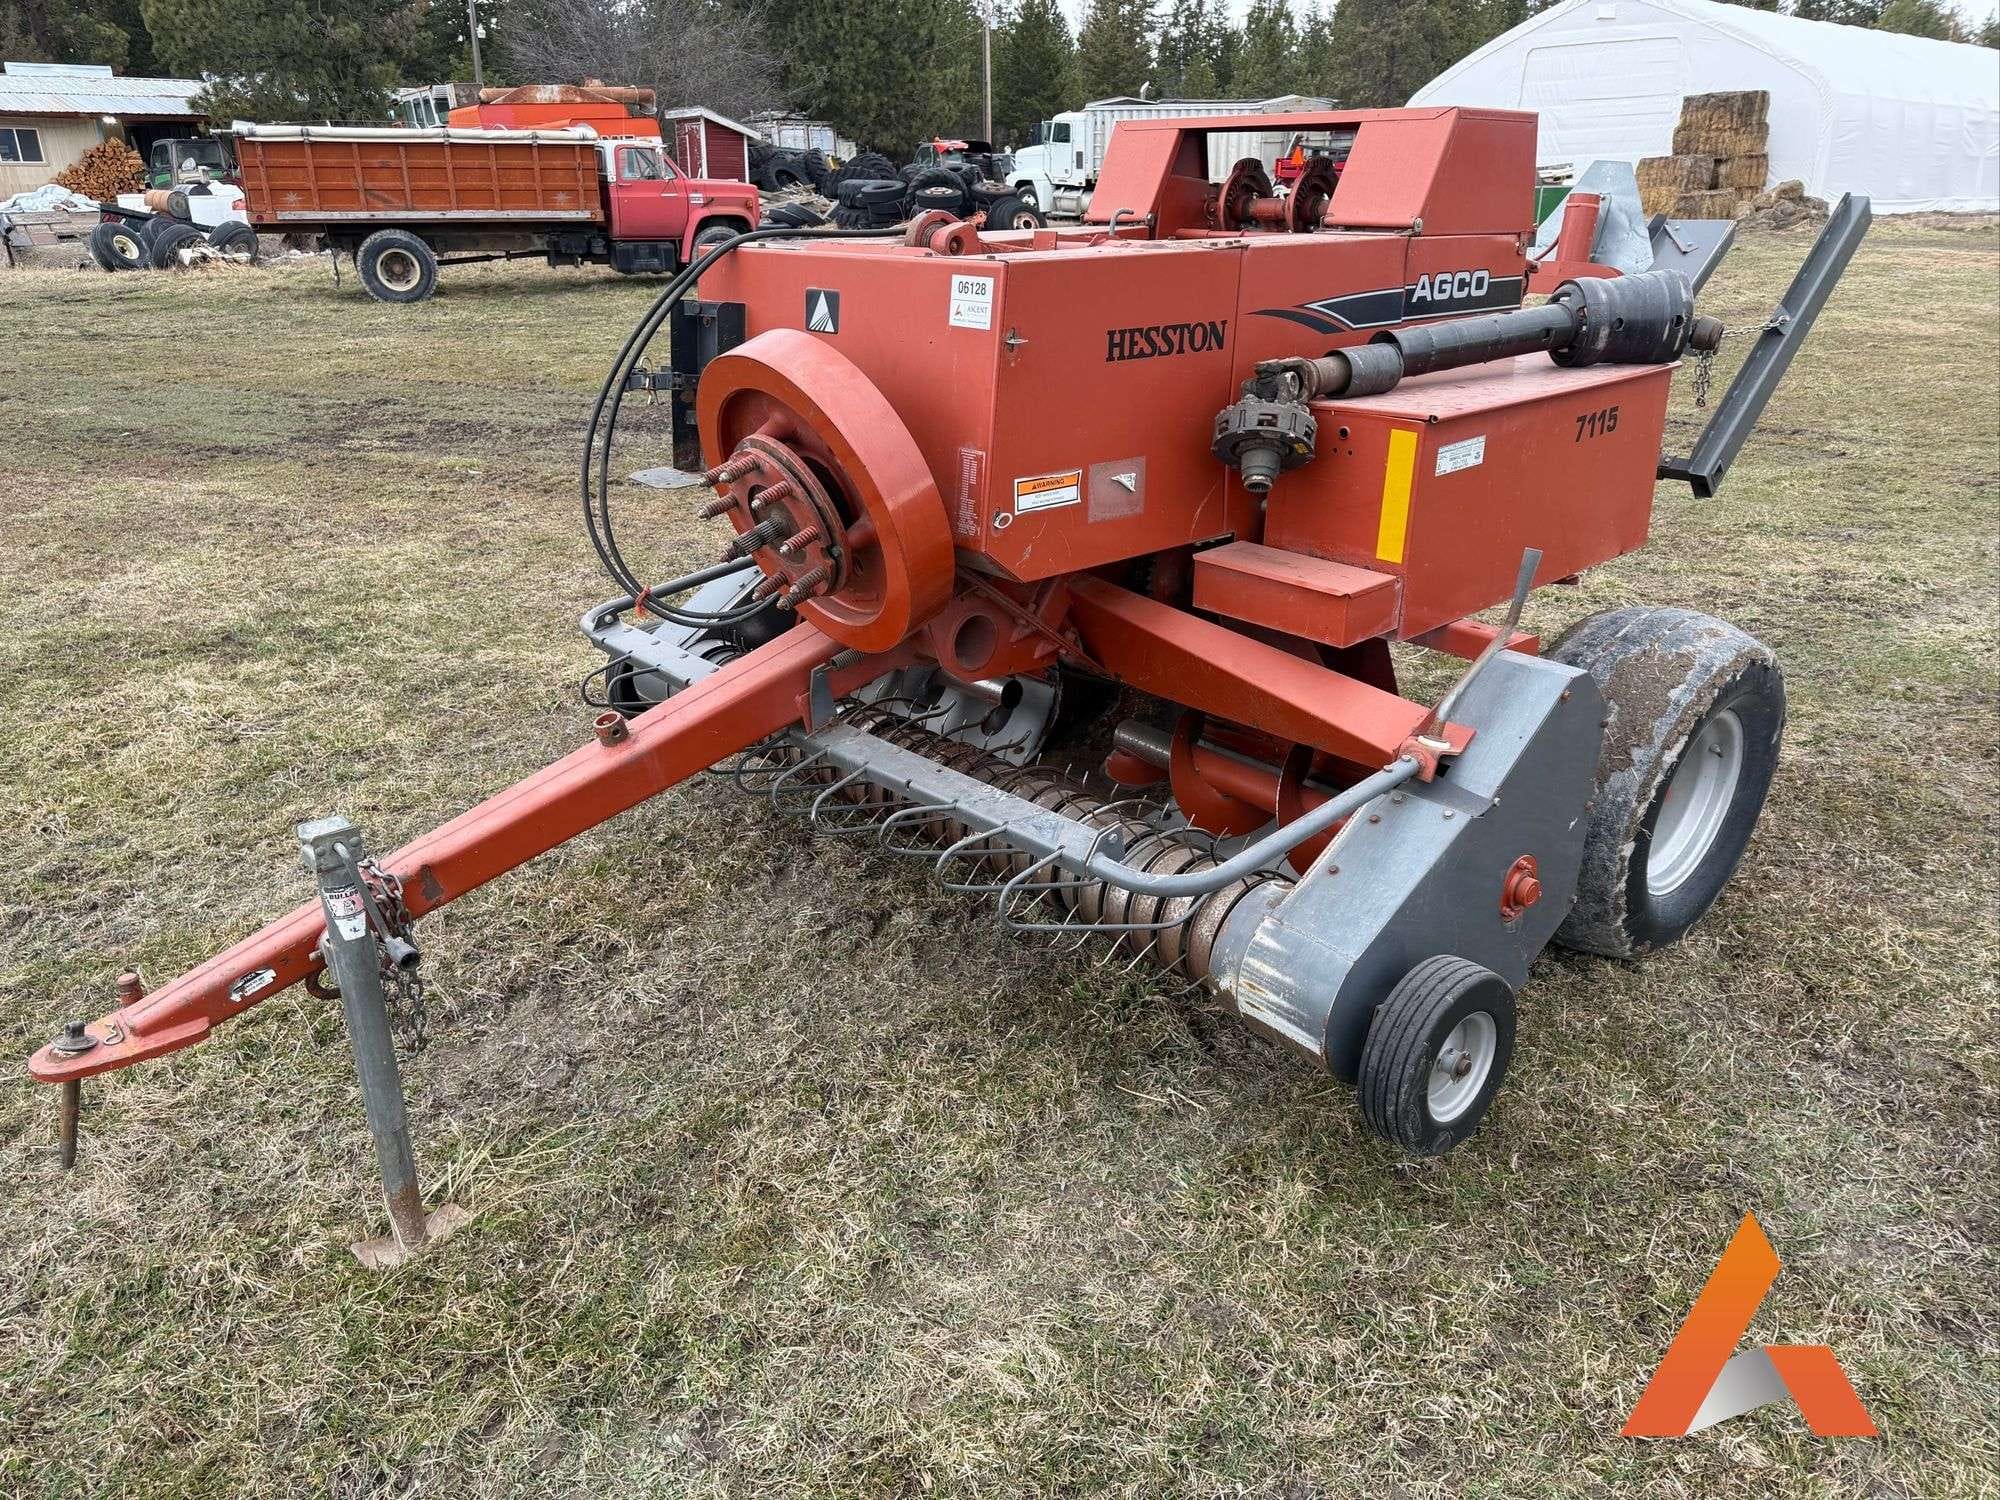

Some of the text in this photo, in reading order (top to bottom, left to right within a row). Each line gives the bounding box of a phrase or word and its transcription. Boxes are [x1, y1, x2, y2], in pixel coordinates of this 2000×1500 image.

[958, 281, 987, 296] 06128
[1411, 268, 1490, 303] AGCO
[1106, 320, 1228, 362] HESSTON
[1575, 405, 1620, 443] 7115
[1036, 478, 1065, 490] WARNING
